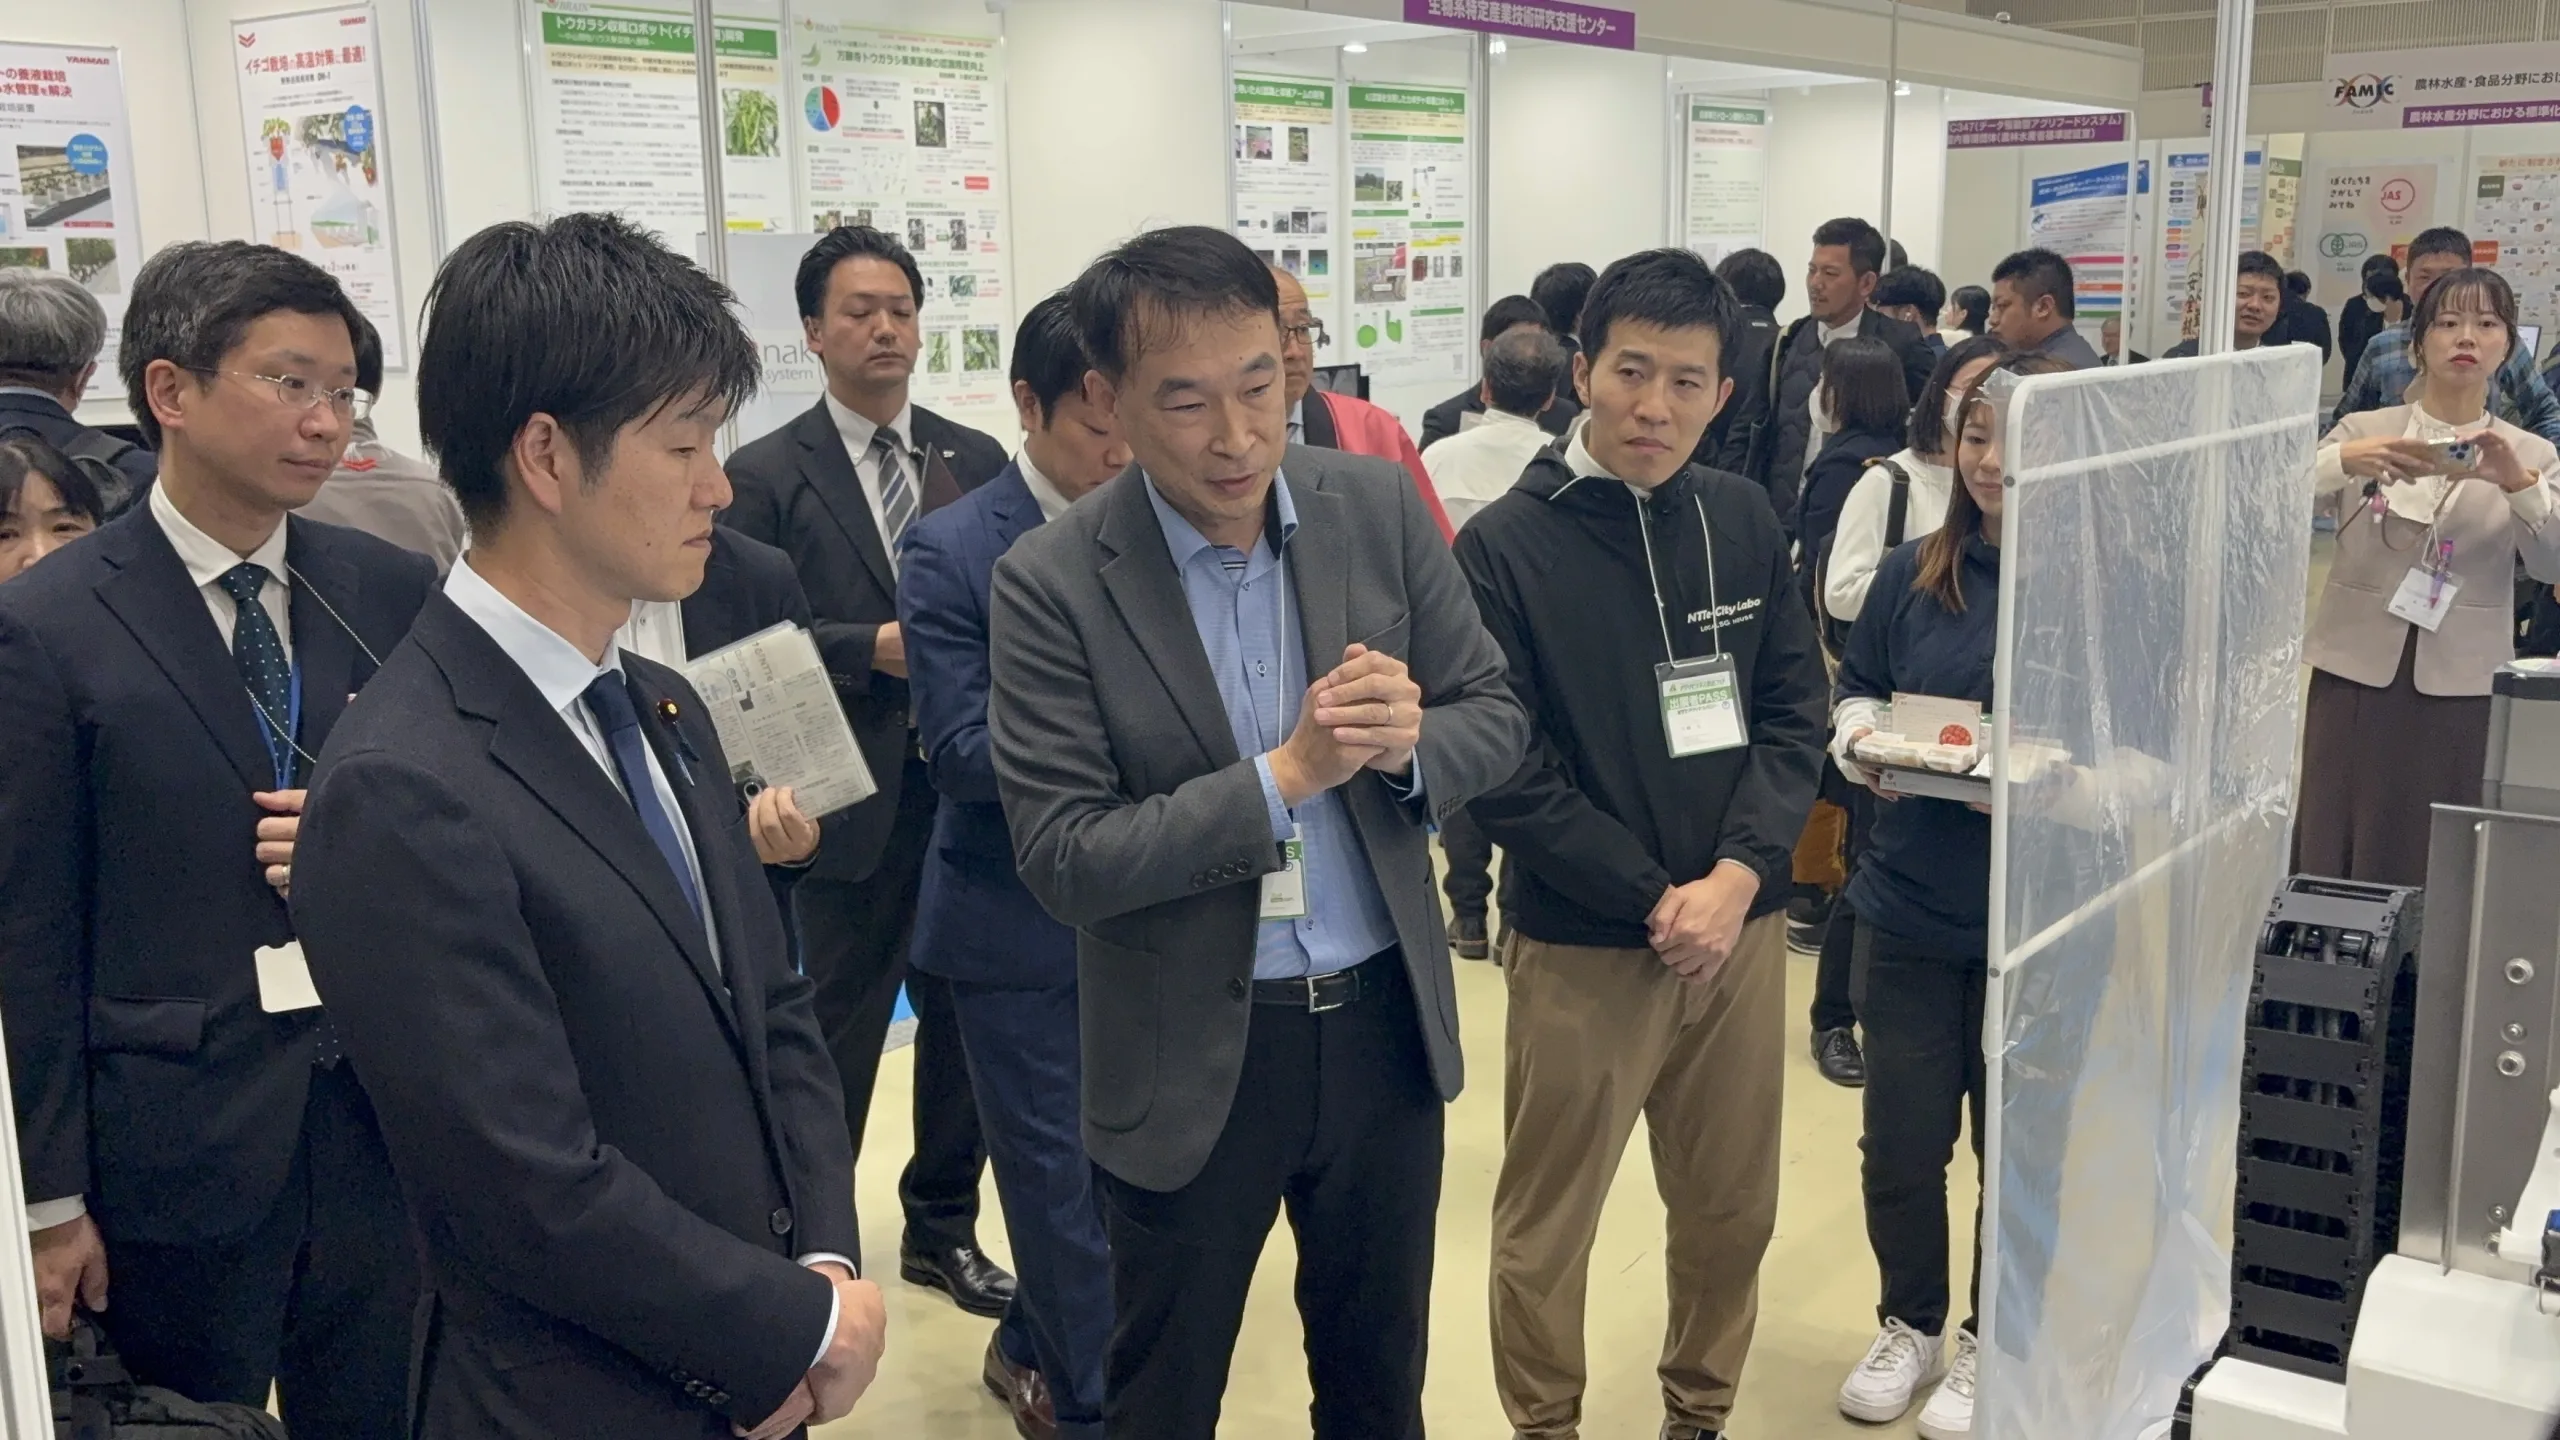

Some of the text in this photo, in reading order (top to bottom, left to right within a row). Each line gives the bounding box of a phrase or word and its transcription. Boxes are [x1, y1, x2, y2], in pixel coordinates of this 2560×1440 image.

[1428, 0, 1616, 37] 生物系特定産業技術研究支援センター
[2334, 84, 2395, 98] FAMIC
[2408, 105, 2560, 124] 農林水産分野における標準化
[2381, 190, 2401, 201] JAS
[765, 368, 814, 384] system
[1736, 598, 1761, 612] Labo
[1733, 613, 1755, 625] HOUSE
